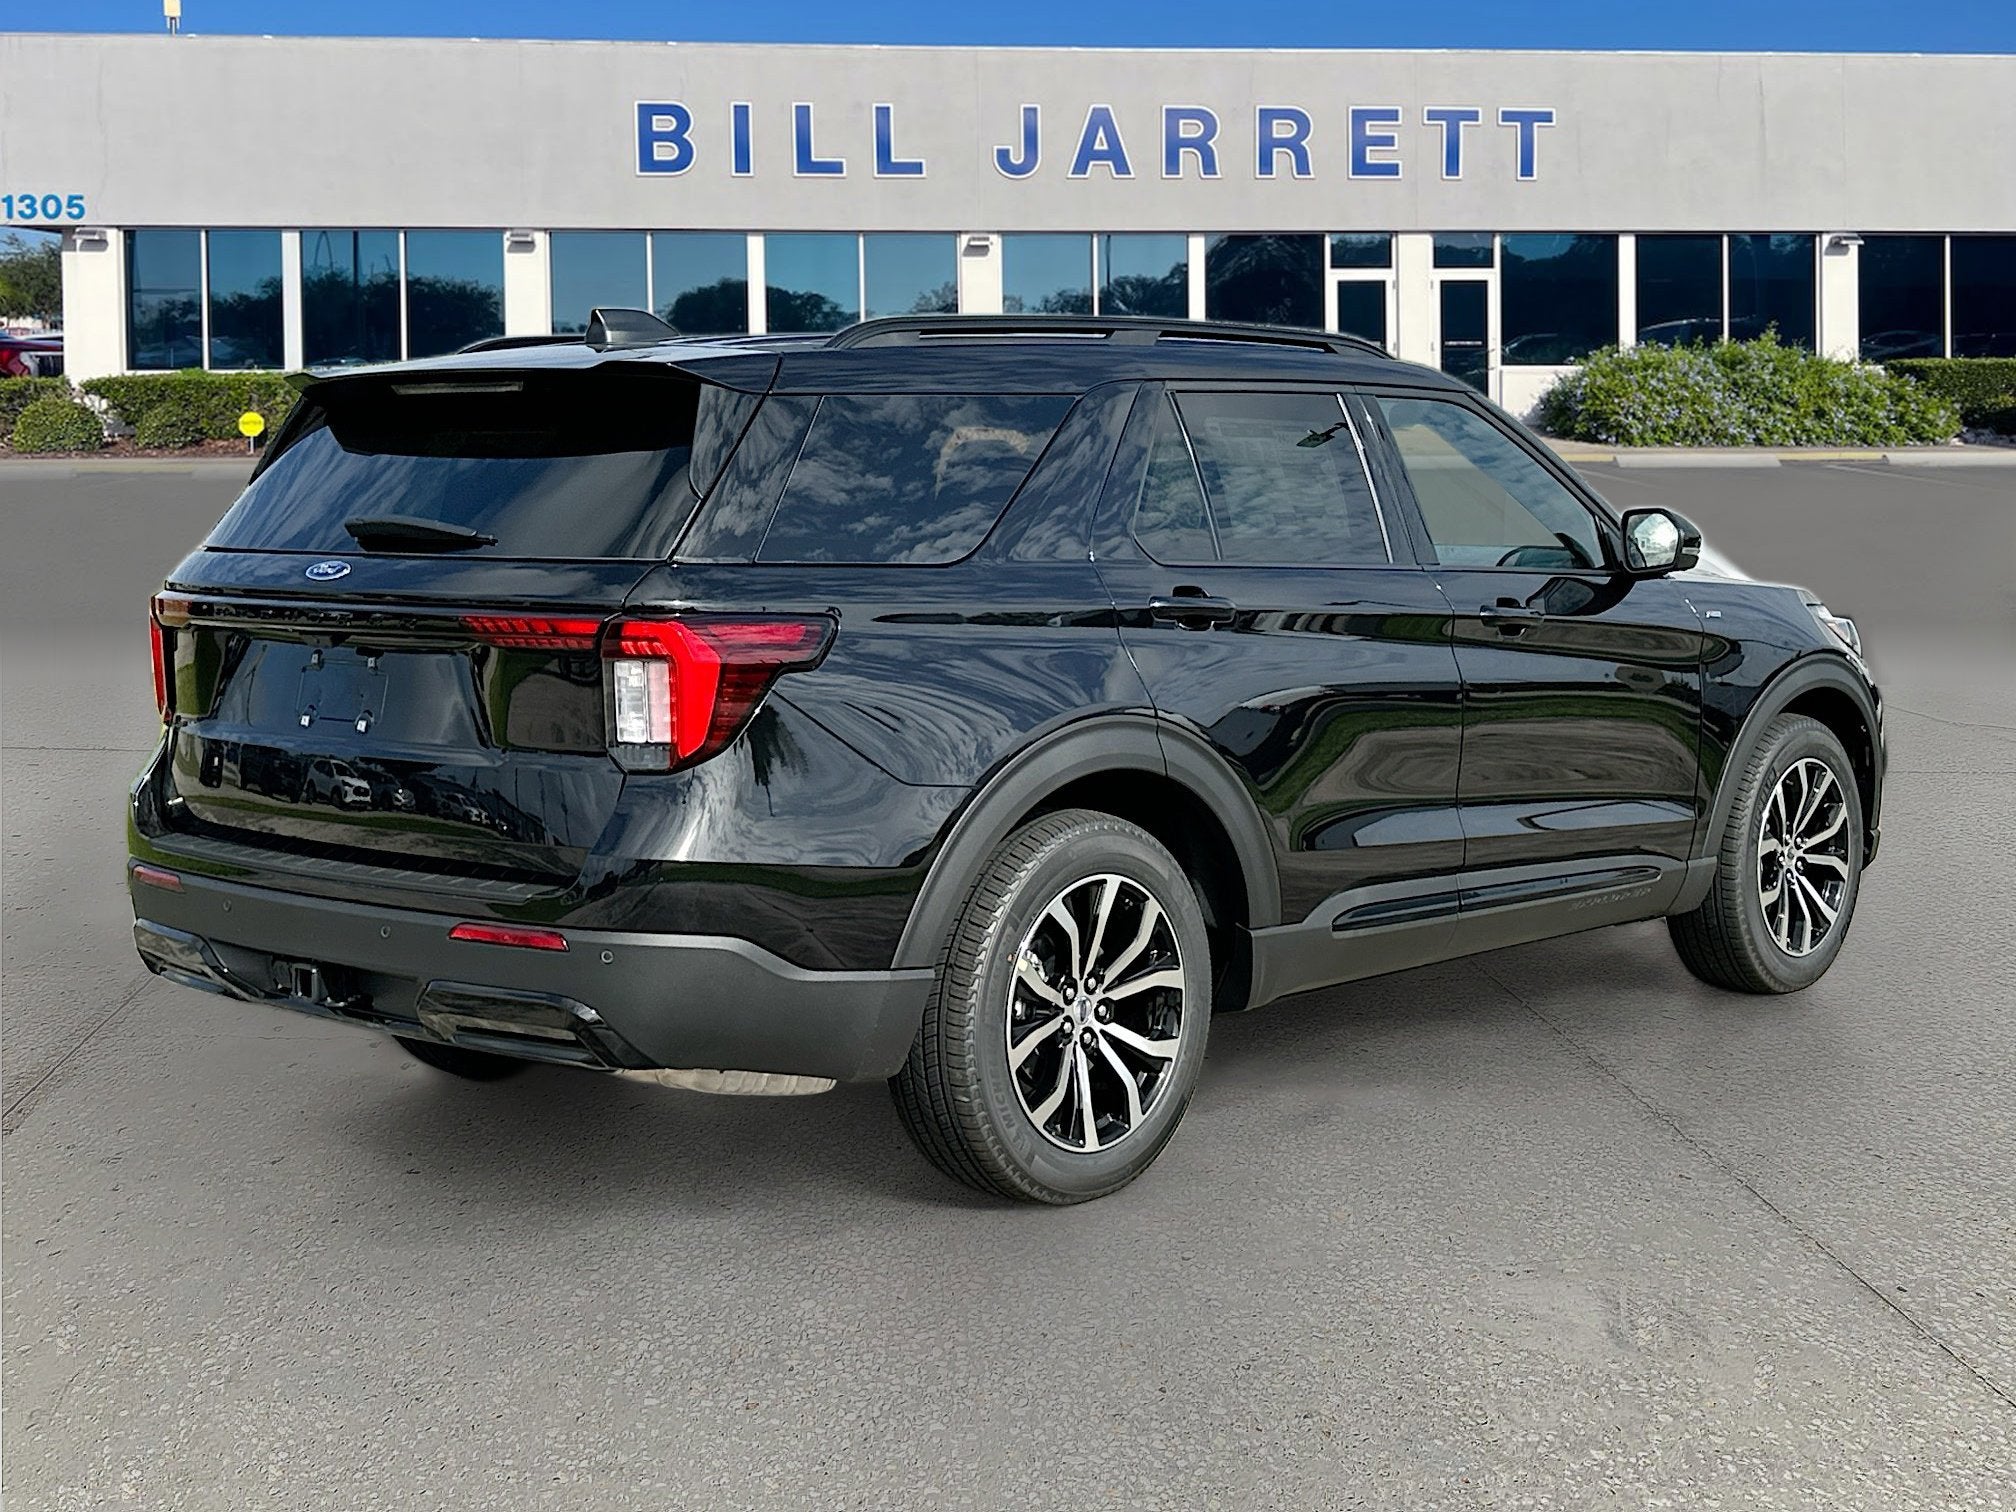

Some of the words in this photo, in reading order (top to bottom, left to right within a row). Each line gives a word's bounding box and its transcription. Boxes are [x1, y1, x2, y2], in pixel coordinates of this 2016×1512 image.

[636, 101, 924, 176] BILL
[994, 106, 1555, 180] JARRETT
[1, 193, 86, 220] 1305
